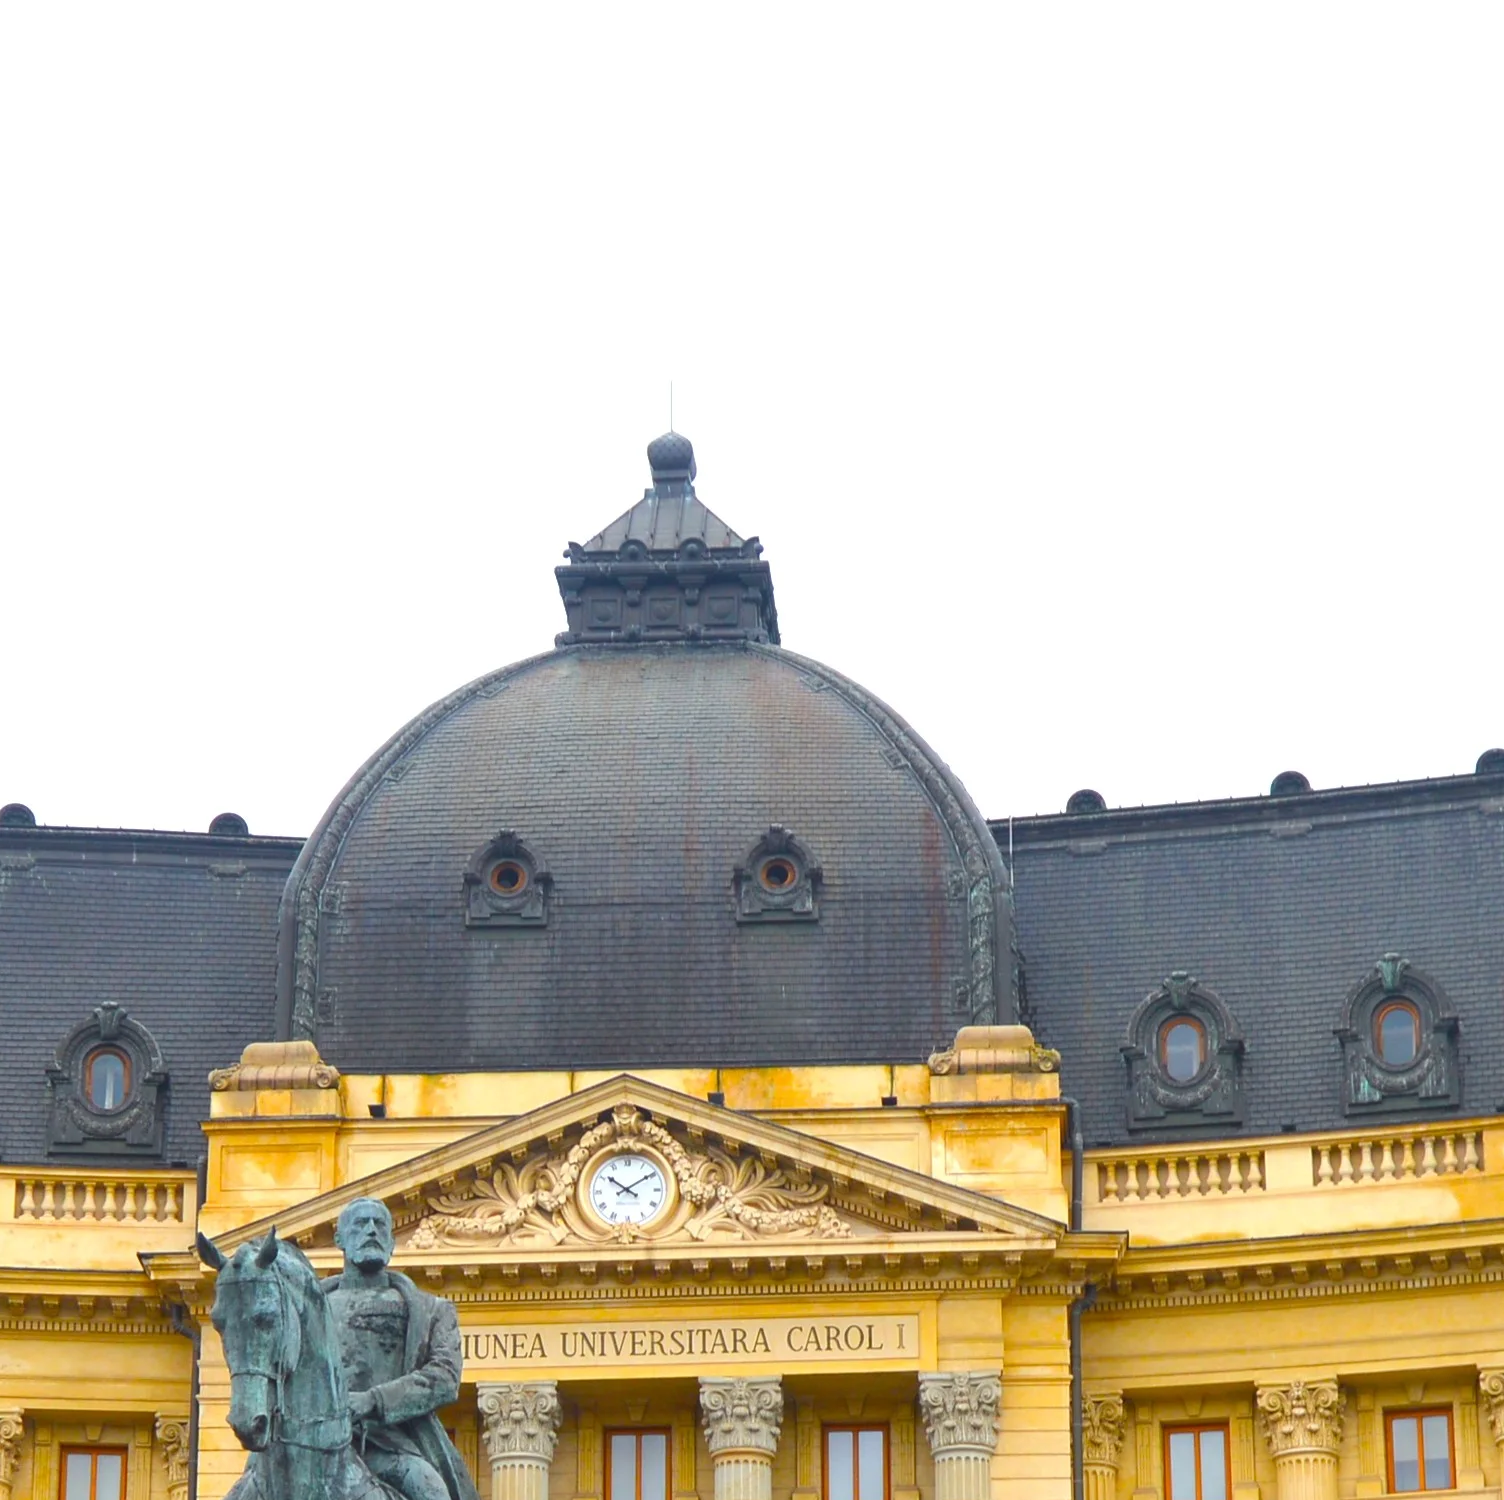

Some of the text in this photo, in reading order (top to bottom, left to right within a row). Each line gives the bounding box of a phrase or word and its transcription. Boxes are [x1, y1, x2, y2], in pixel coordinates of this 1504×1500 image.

[464, 1323, 905, 1360] IUNEA UNIVERSITARA CAROL I
